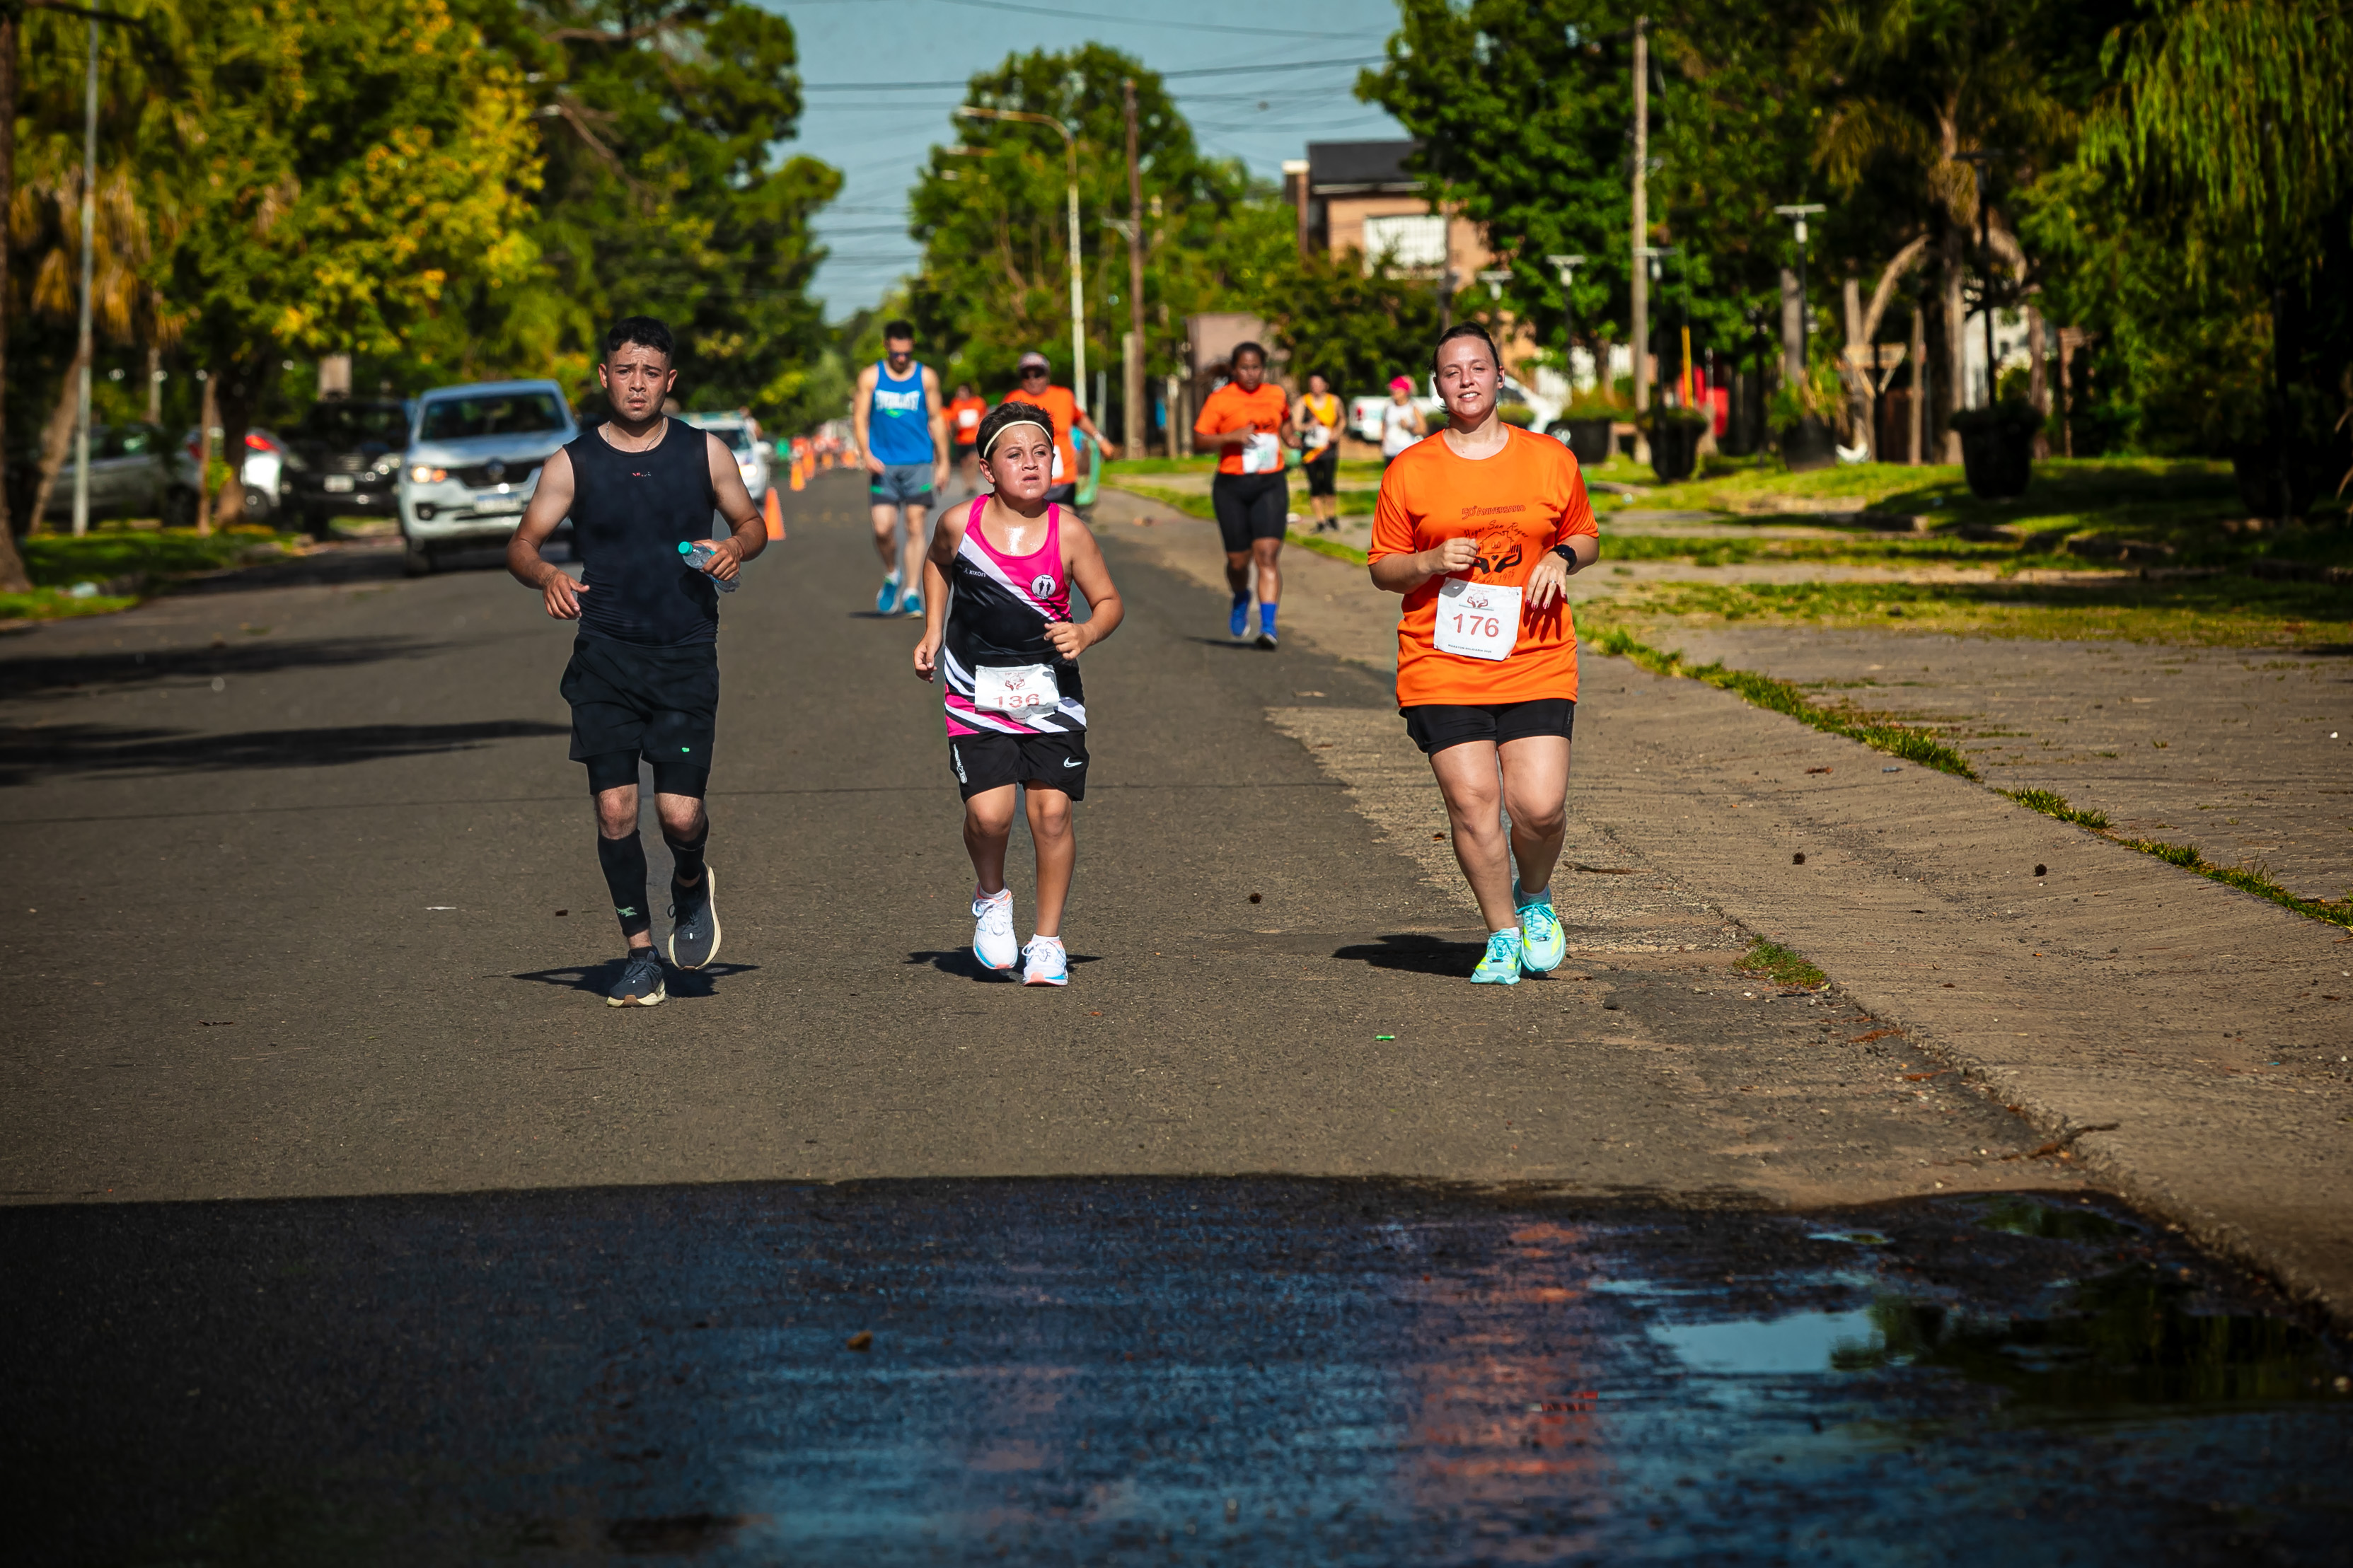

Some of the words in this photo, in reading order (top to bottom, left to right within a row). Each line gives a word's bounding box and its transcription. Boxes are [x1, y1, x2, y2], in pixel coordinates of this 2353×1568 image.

[1476, 504, 1526, 516] ANIVERSARIO
[1487, 519, 1504, 530] San
[1453, 613, 1499, 637] 176
[993, 693, 1039, 708] 136
